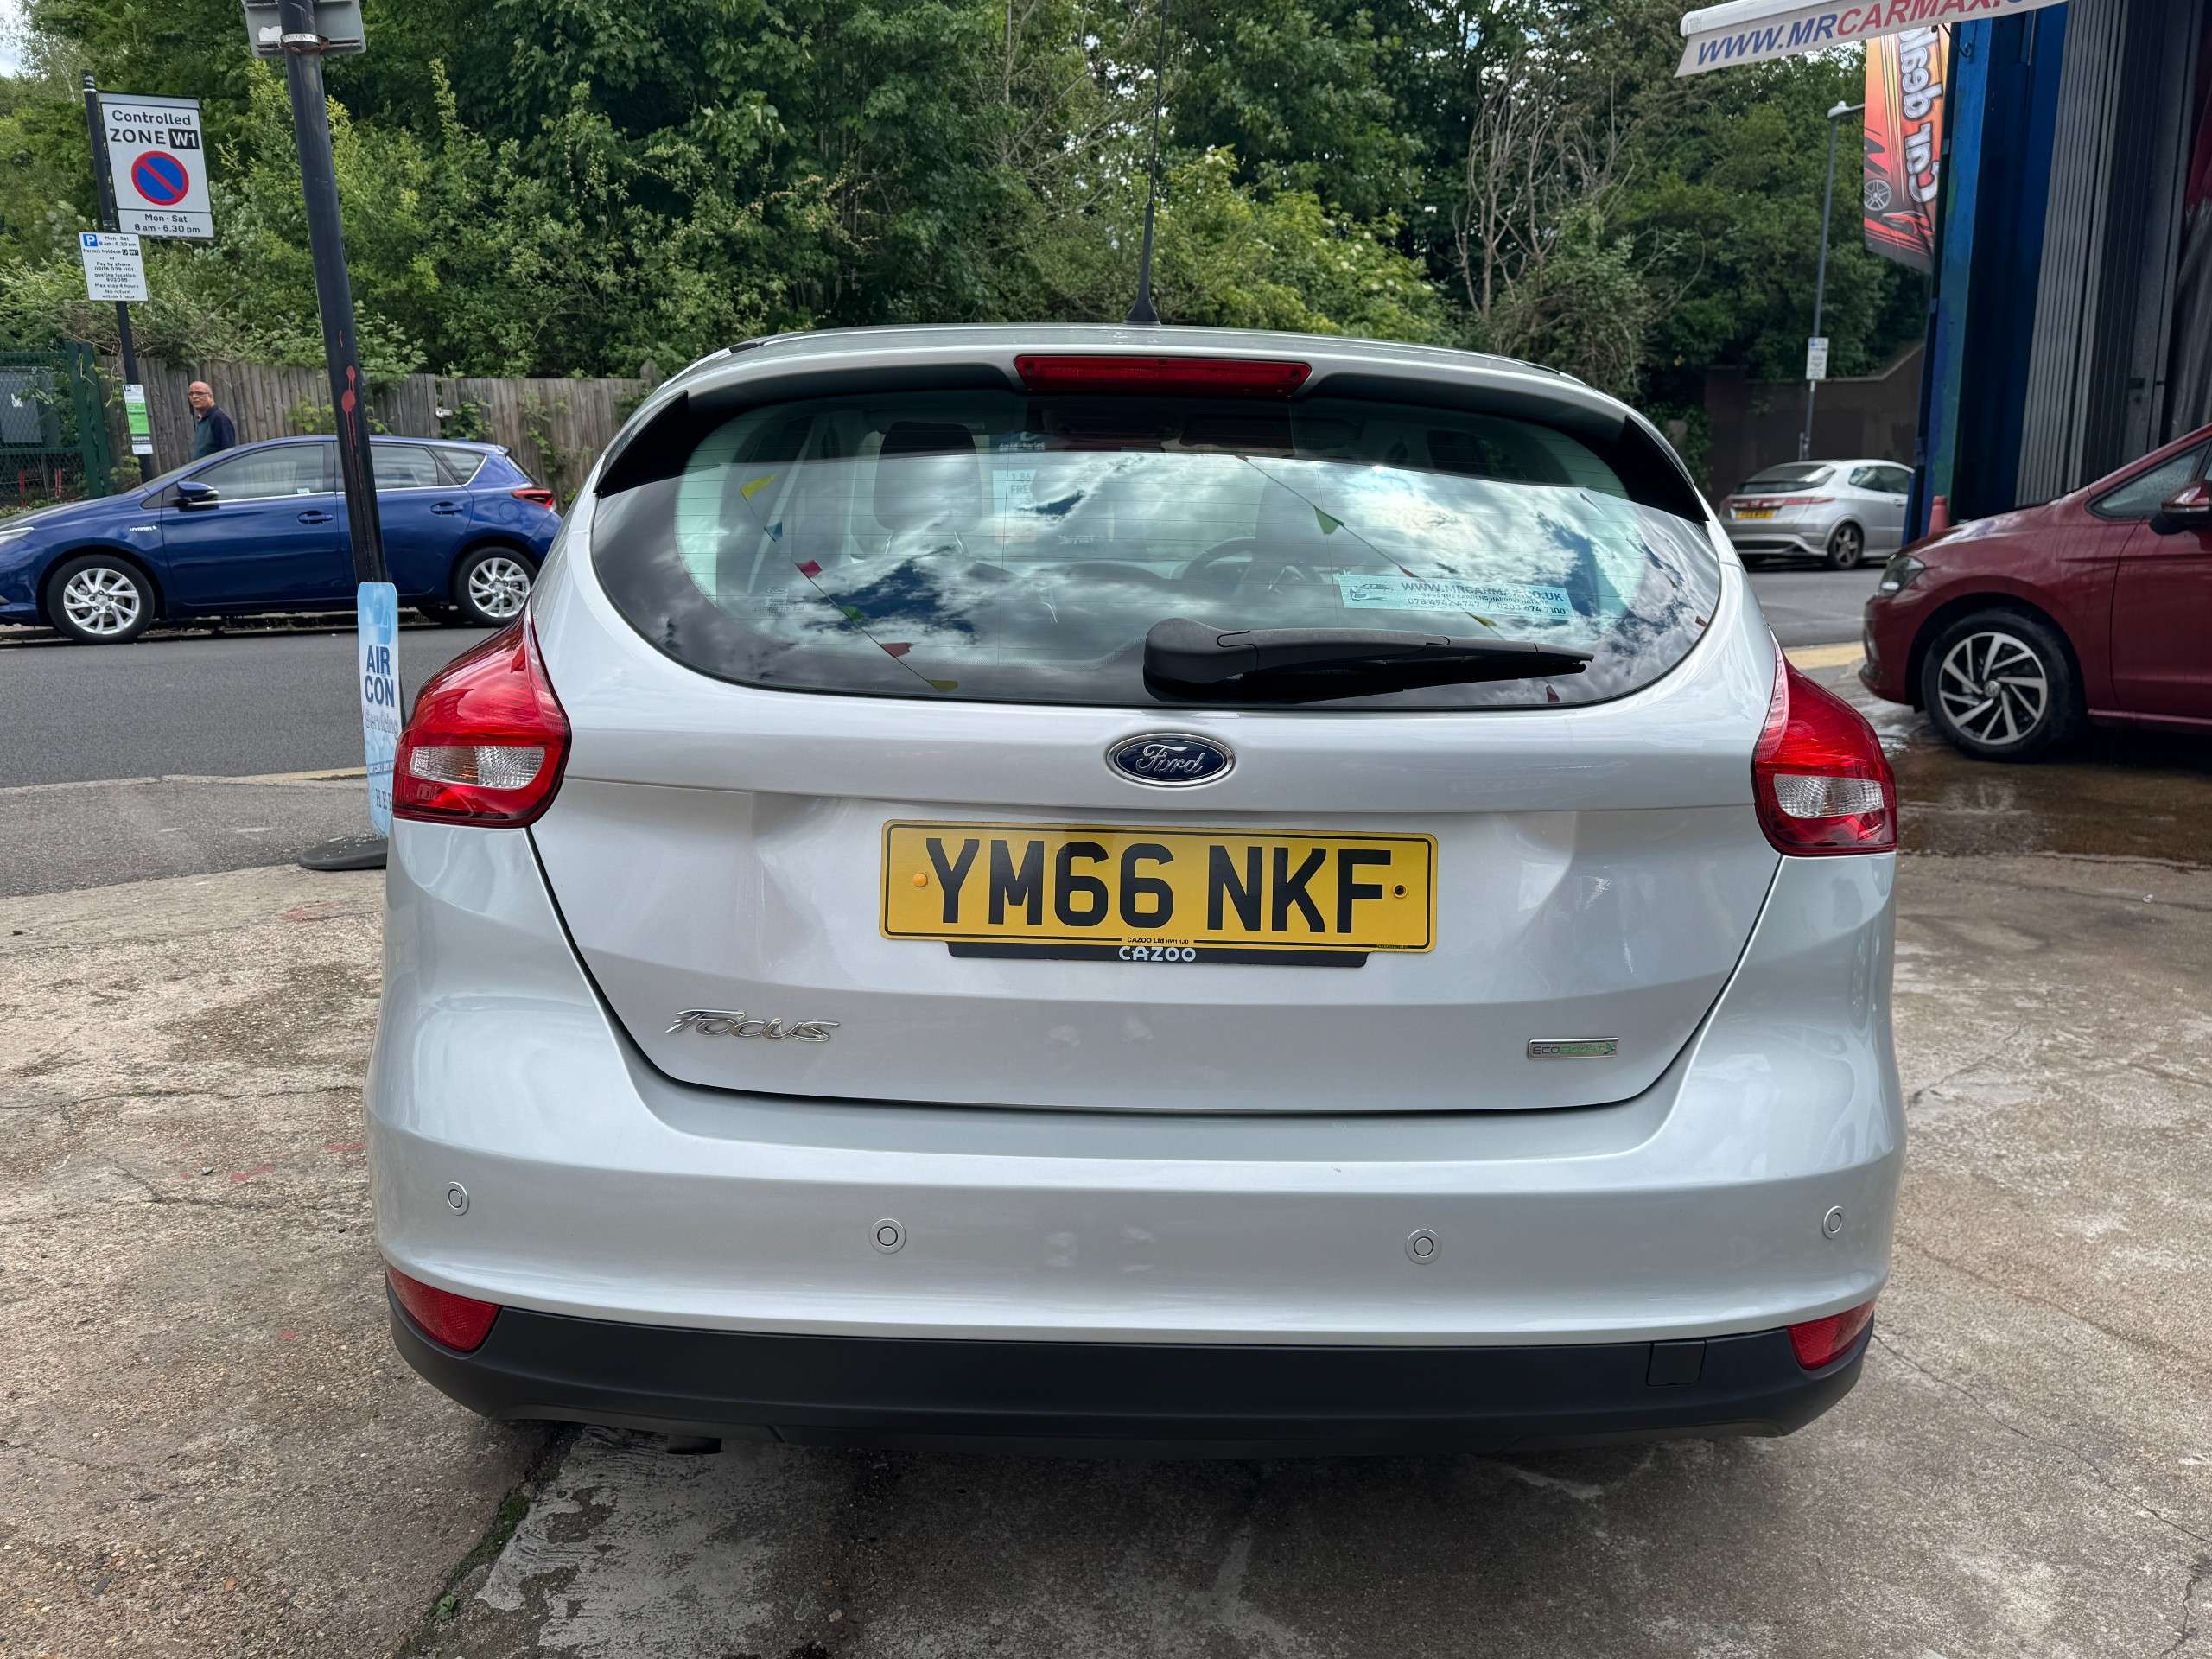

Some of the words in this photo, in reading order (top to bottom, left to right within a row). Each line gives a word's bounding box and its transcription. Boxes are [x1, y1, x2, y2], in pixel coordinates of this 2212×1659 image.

[1697, 0, 2024, 66] WWW.MRCARMA.
[111, 110, 191, 126] Controlled
[109, 128, 167, 145] ZONE
[171, 130, 198, 148] W1
[144, 213, 164, 222] Mon
[171, 214, 188, 223] Sat
[162, 224, 185, 233] 6.30
[187, 226, 200, 234] pm
[86, 234, 96, 245] P
[365, 645, 391, 676] AIR
[364, 675, 396, 708] CON
[1135, 743, 1205, 774] Ford
[925, 837, 1175, 929] YM66
[1206, 844, 1392, 934] NKF
[1118, 945, 1197, 963] CAZOO
[664, 1008, 841, 1043] Focus
